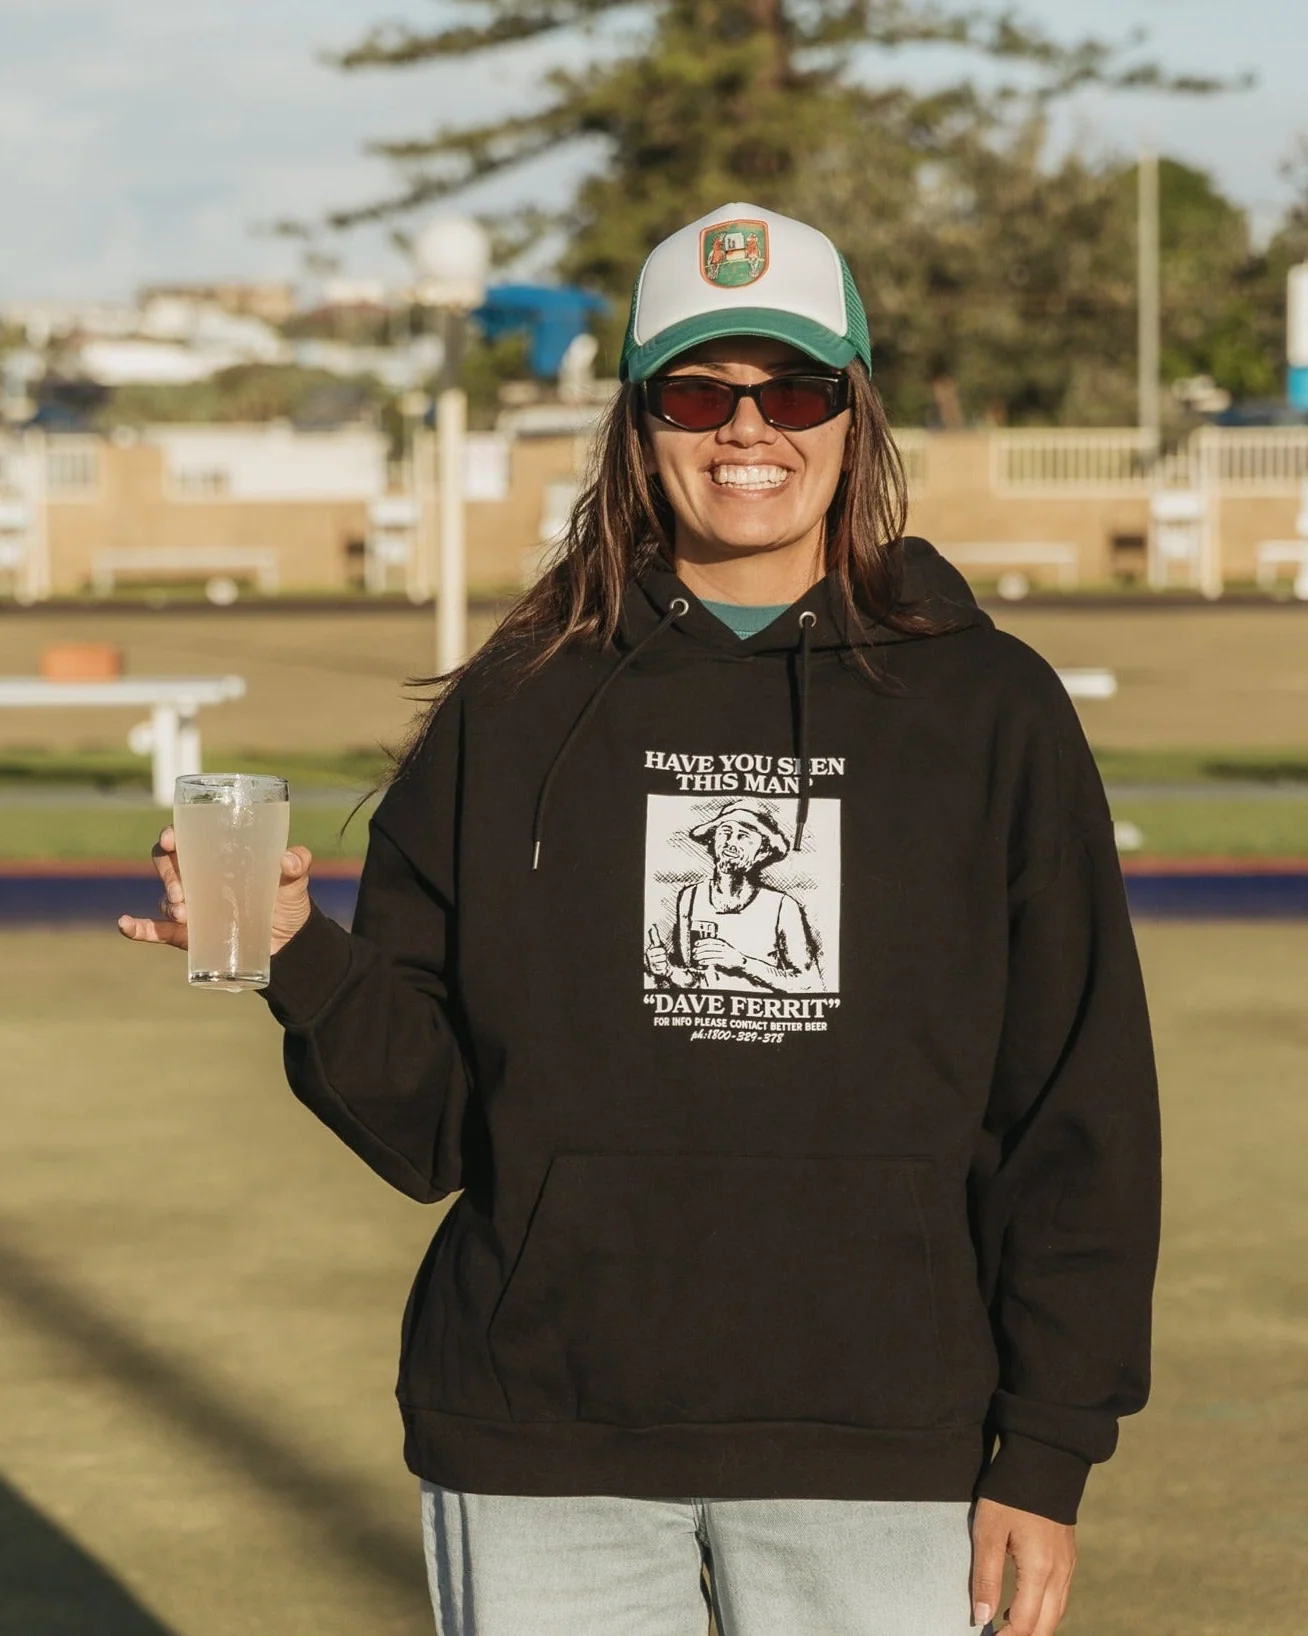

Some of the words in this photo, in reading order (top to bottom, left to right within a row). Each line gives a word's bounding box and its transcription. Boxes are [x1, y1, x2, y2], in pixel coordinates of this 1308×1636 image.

[644, 750, 715, 773] HAVE
[718, 753, 773, 774] YOU
[675, 773, 739, 791] THIS
[743, 773, 814, 794] MAN
[653, 1017, 670, 1026] FOR
[671, 1016, 692, 1026] INFO
[694, 1017, 727, 1028] PLEASE
[729, 1019, 768, 1031] CONTACT
[769, 1021, 803, 1032] BETTER
[804, 1022, 828, 1032] BEER
